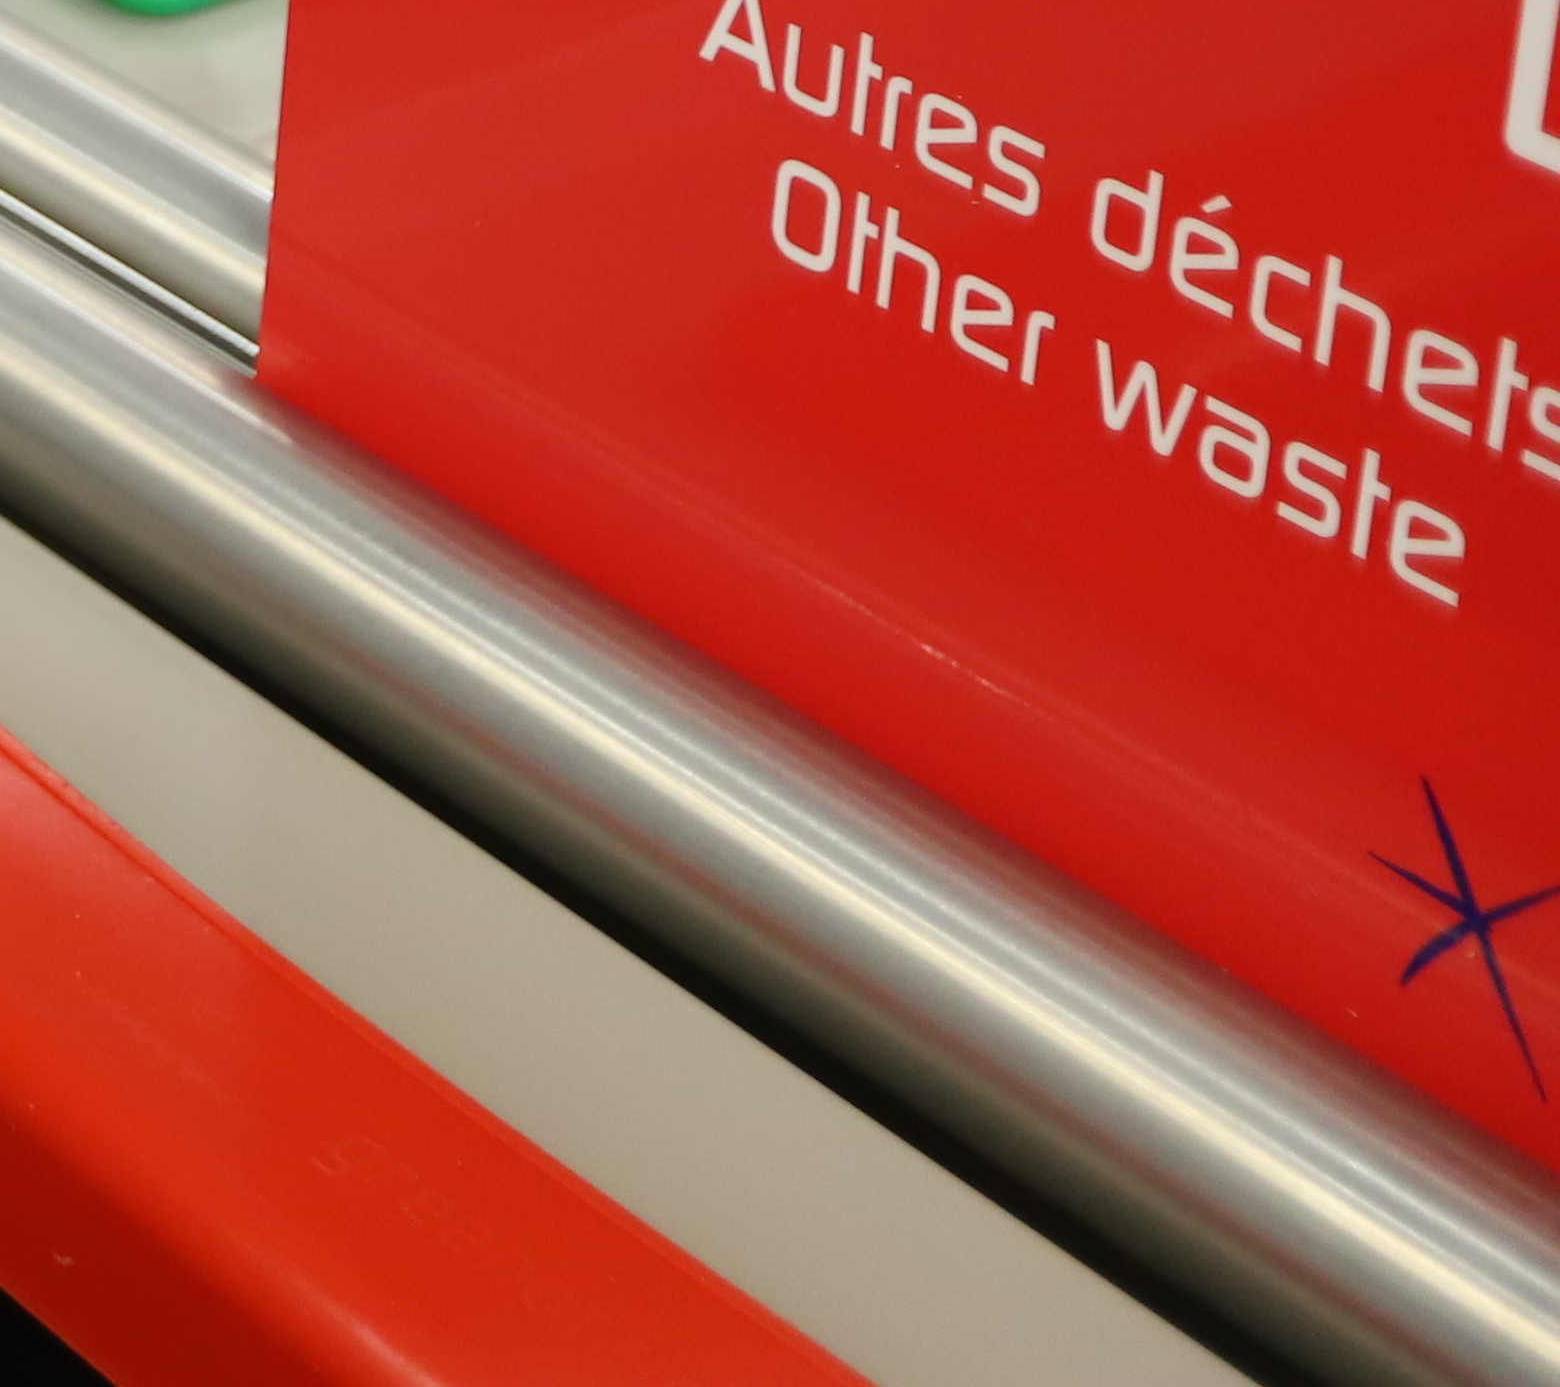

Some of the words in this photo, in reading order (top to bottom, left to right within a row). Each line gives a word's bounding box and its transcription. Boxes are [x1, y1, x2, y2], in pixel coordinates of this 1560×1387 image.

[771, 158, 1056, 386] Other
[1095, 337, 1467, 607] waste
[1089, 169, 1560, 482] déchets
